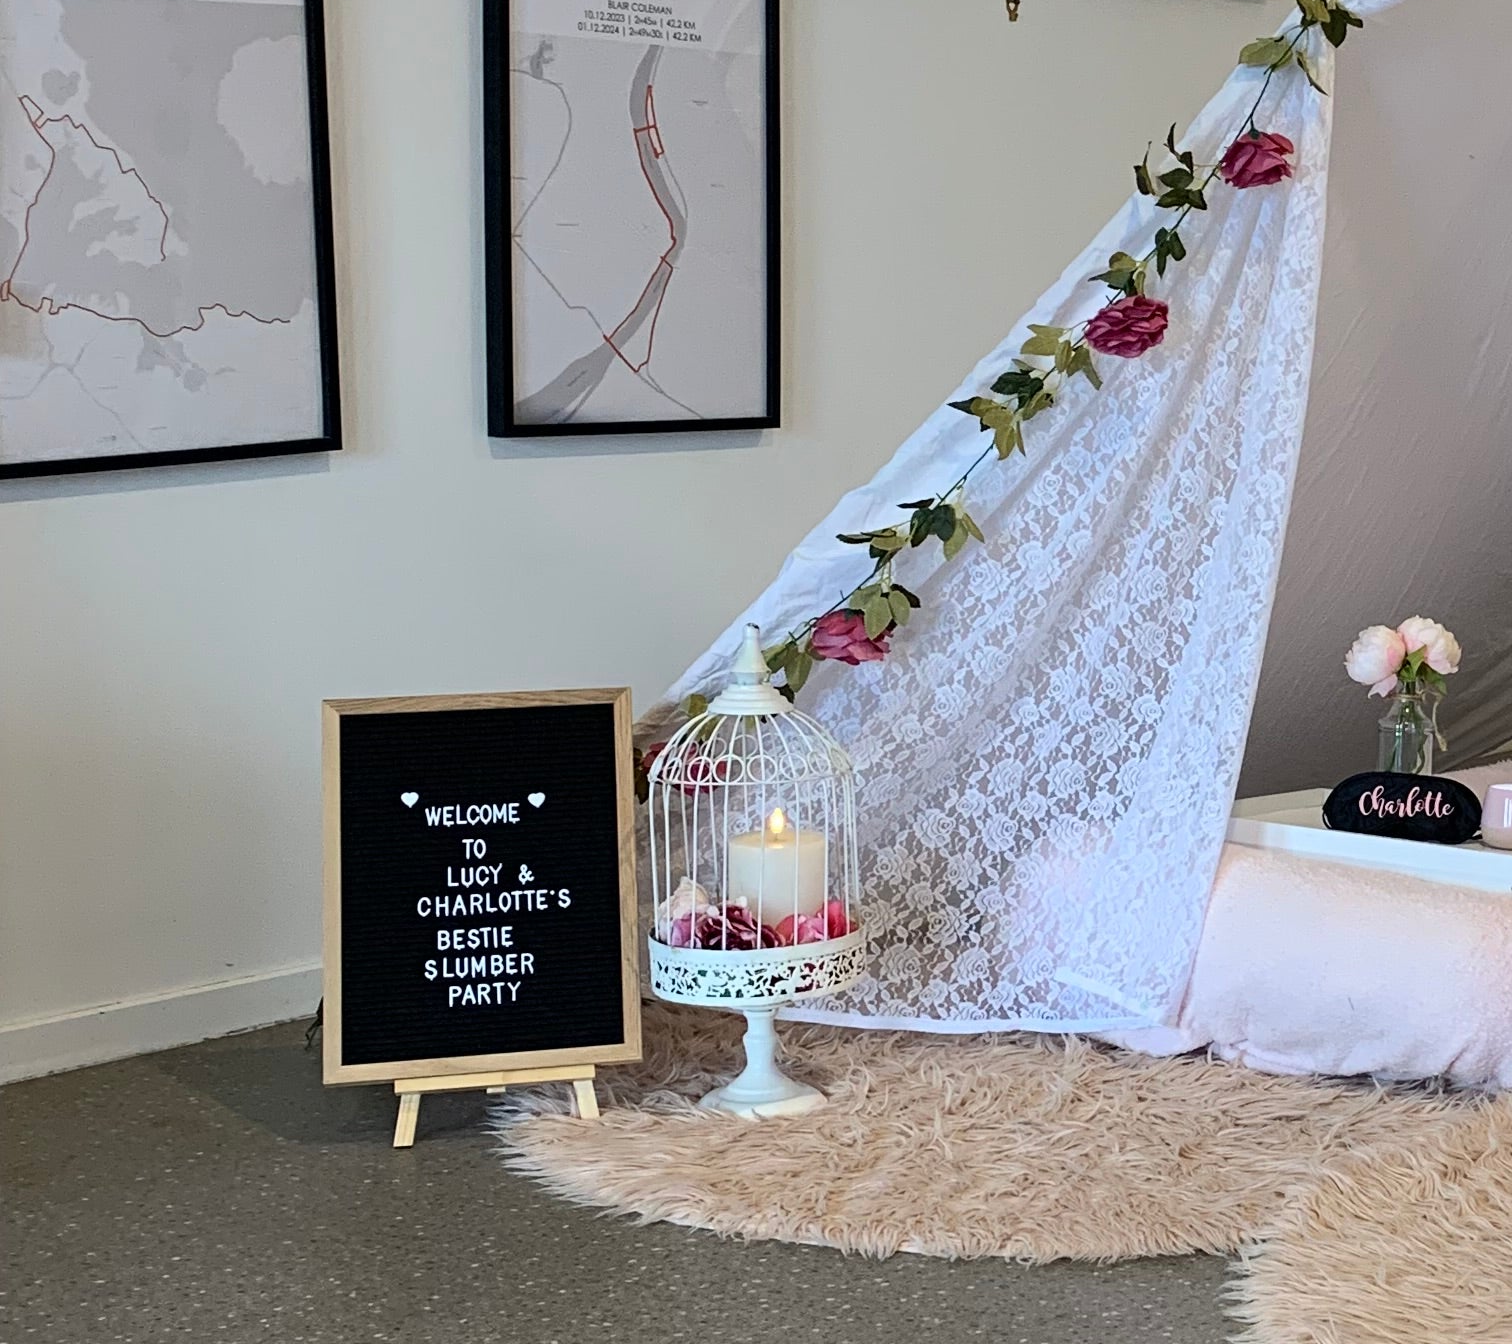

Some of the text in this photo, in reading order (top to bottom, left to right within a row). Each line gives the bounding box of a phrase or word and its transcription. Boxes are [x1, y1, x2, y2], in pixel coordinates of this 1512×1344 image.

[608, 0, 672, 15] BLAIR COLEMAN
[1358, 785, 1455, 818] Charlotte
[425, 803, 520, 827] WELCOME
[462, 838, 487, 859] TO
[447, 863, 535, 887] LUCY &
[417, 889, 571, 917] CHARLOTTE'S
[437, 926, 513, 951] BESTIE
[424, 953, 534, 981] SLUMBER
[448, 982, 521, 1007] PARTY
